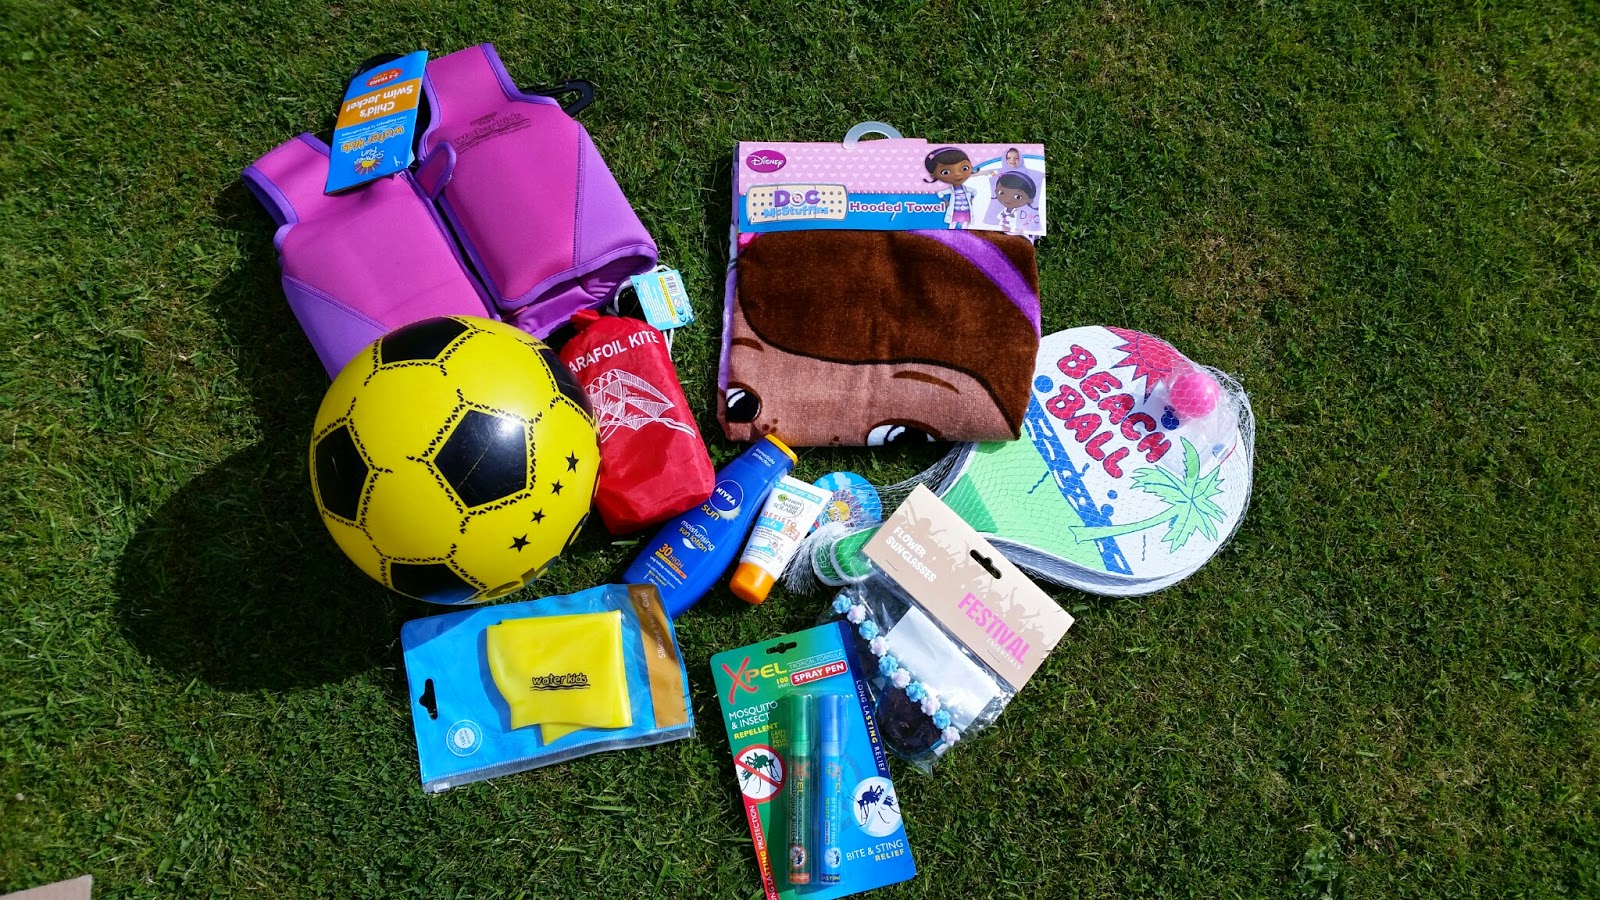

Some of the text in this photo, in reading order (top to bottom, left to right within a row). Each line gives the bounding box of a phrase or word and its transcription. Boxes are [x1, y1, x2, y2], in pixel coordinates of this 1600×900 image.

[346, 85, 414, 112] Swim Jacket
[359, 101, 395, 118] Child's
[340, 137, 366, 154] kids
[364, 125, 405, 145] water
[748, 153, 784, 168] Disney
[761, 206, 829, 219] McStuffins
[849, 202, 946, 213] Hooded Towel
[568, 329, 660, 374] ARAFOIL KITE
[1056, 344, 1172, 464] BEACH
[1045, 384, 1130, 479] BALL
[715, 487, 736, 506] NIVEA
[701, 504, 720, 521] sun
[763, 511, 798, 528] RESISTO
[679, 527, 708, 553] sun lotion
[681, 520, 716, 552] moisturising
[892, 525, 928, 559] FLOWER
[658, 543, 674, 557] 30
[669, 554, 685, 569] HIGH
[885, 536, 937, 584] SUNGLASSES
[957, 591, 1031, 665] FESTIVAL
[789, 651, 843, 670] TROPICAL FORMULA
[986, 638, 1022, 671] ESSENTIALS
[531, 672, 588, 686] water kids
[776, 663, 845, 686] 100 SPRAY PEN
[728, 700, 778, 721] MOSQUITO
[731, 712, 770, 730] & INSECT
[734, 722, 778, 739] REPELLENT
[856, 680, 886, 772] LONG LASTING RELIEF
[749, 805, 764, 850] PROTECTION
[846, 839, 904, 861] BITE & STING
[875, 849, 905, 862] RELIEF
[760, 851, 773, 885] LASTING
